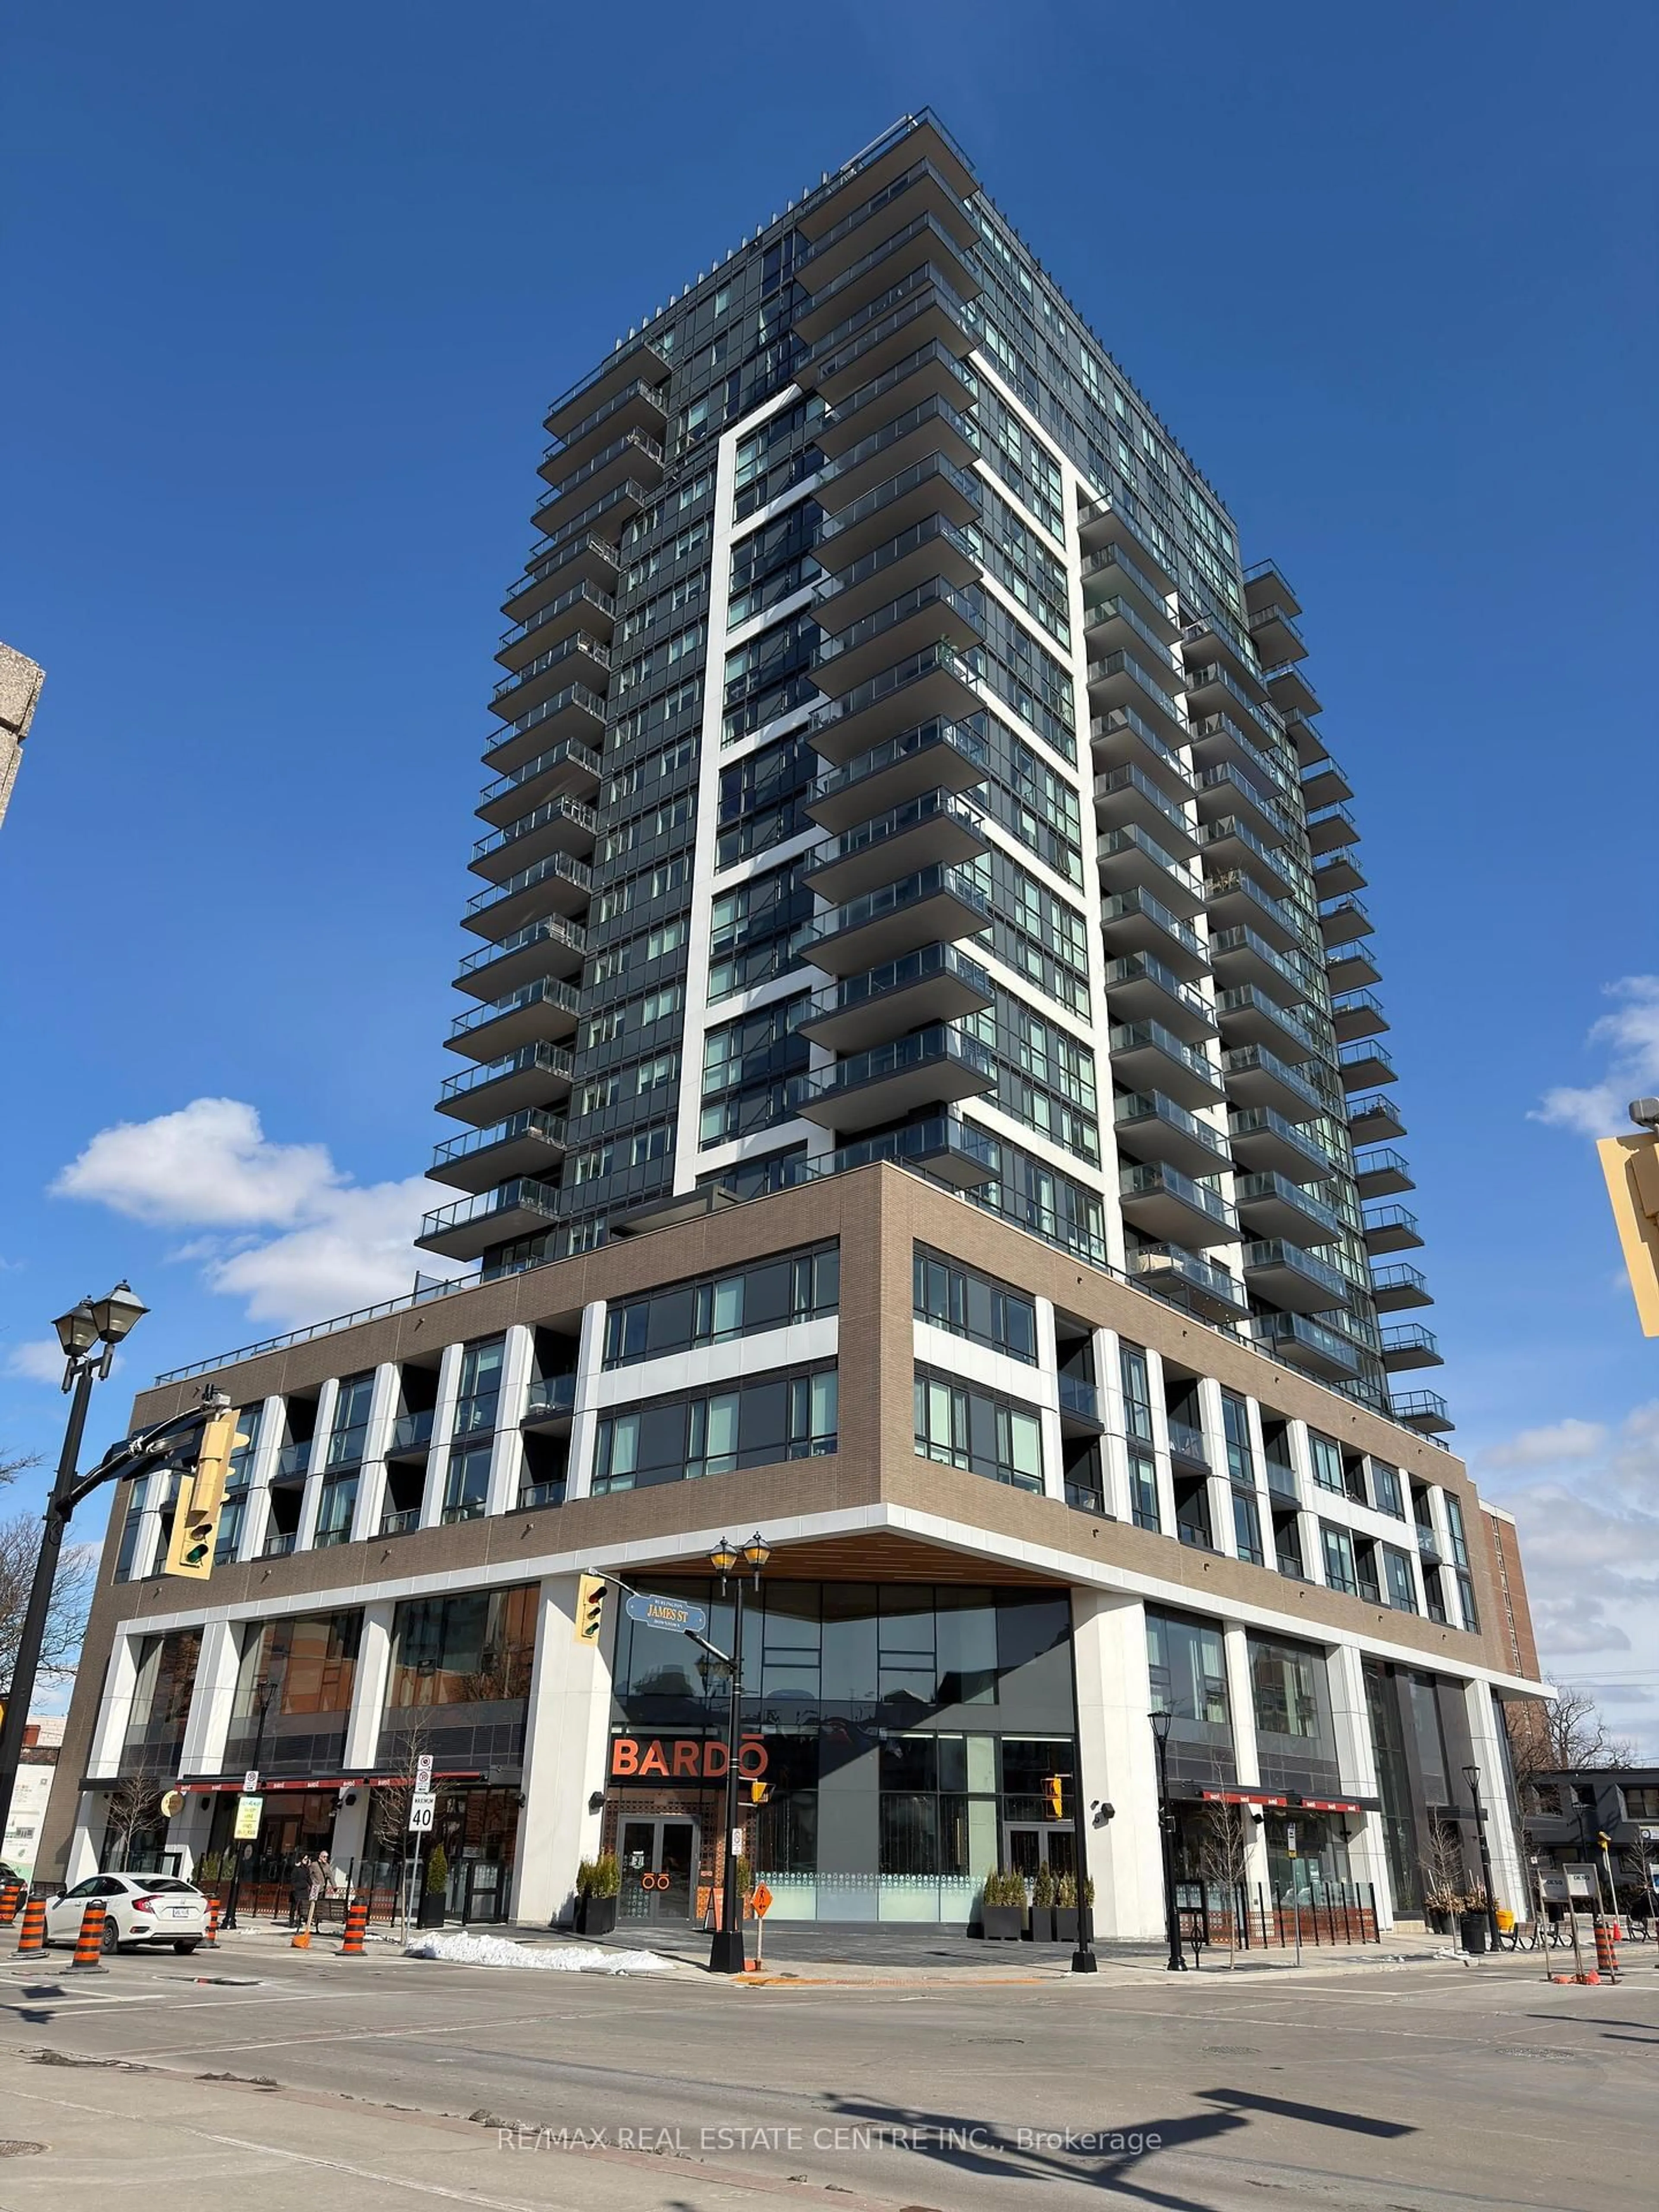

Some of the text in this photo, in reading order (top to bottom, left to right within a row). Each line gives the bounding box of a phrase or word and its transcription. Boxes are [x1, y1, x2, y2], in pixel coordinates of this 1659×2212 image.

[647, 1604, 688, 1623] JAMES ST
[413, 1809, 431, 1825] 40
